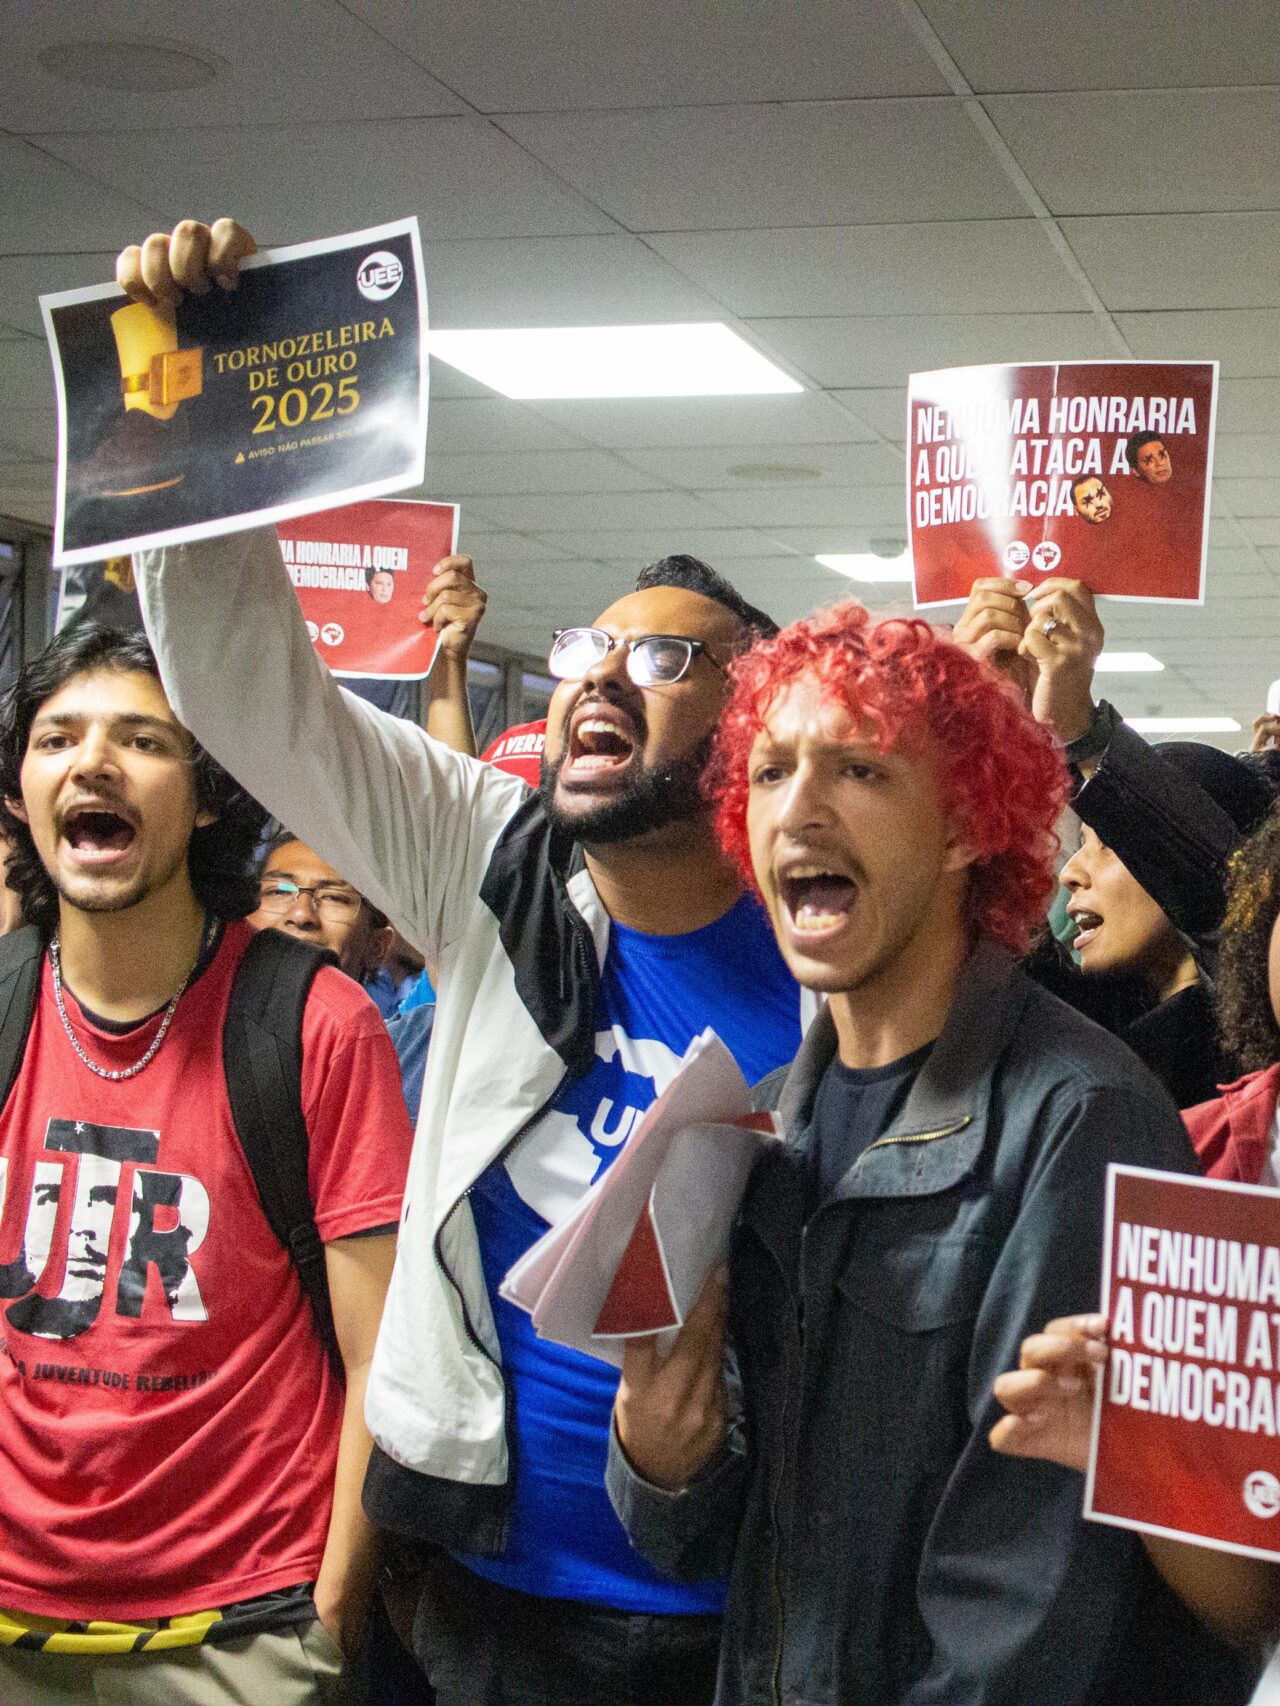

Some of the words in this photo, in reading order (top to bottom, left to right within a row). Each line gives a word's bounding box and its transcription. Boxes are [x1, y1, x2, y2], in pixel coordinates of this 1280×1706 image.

[361, 263, 401, 288] UEE
[214, 317, 395, 374] TORNOZELEIRA
[250, 367, 279, 392] DE
[287, 351, 358, 382] OURO
[251, 375, 361, 434] 2025
[1048, 396, 1197, 435] HONRARIA
[914, 448, 931, 487] A
[1009, 437, 1103, 475] ATACA
[1110, 437, 1131, 475] A
[296, 540, 361, 567] HONRARIA
[362, 545, 372, 567] A
[373, 546, 409, 572] QUEM
[1111, 1286, 1135, 1342] A
[1140, 1292, 1238, 1364] QUEM
[34, 1362, 130, 1391] JUVENTUDE
